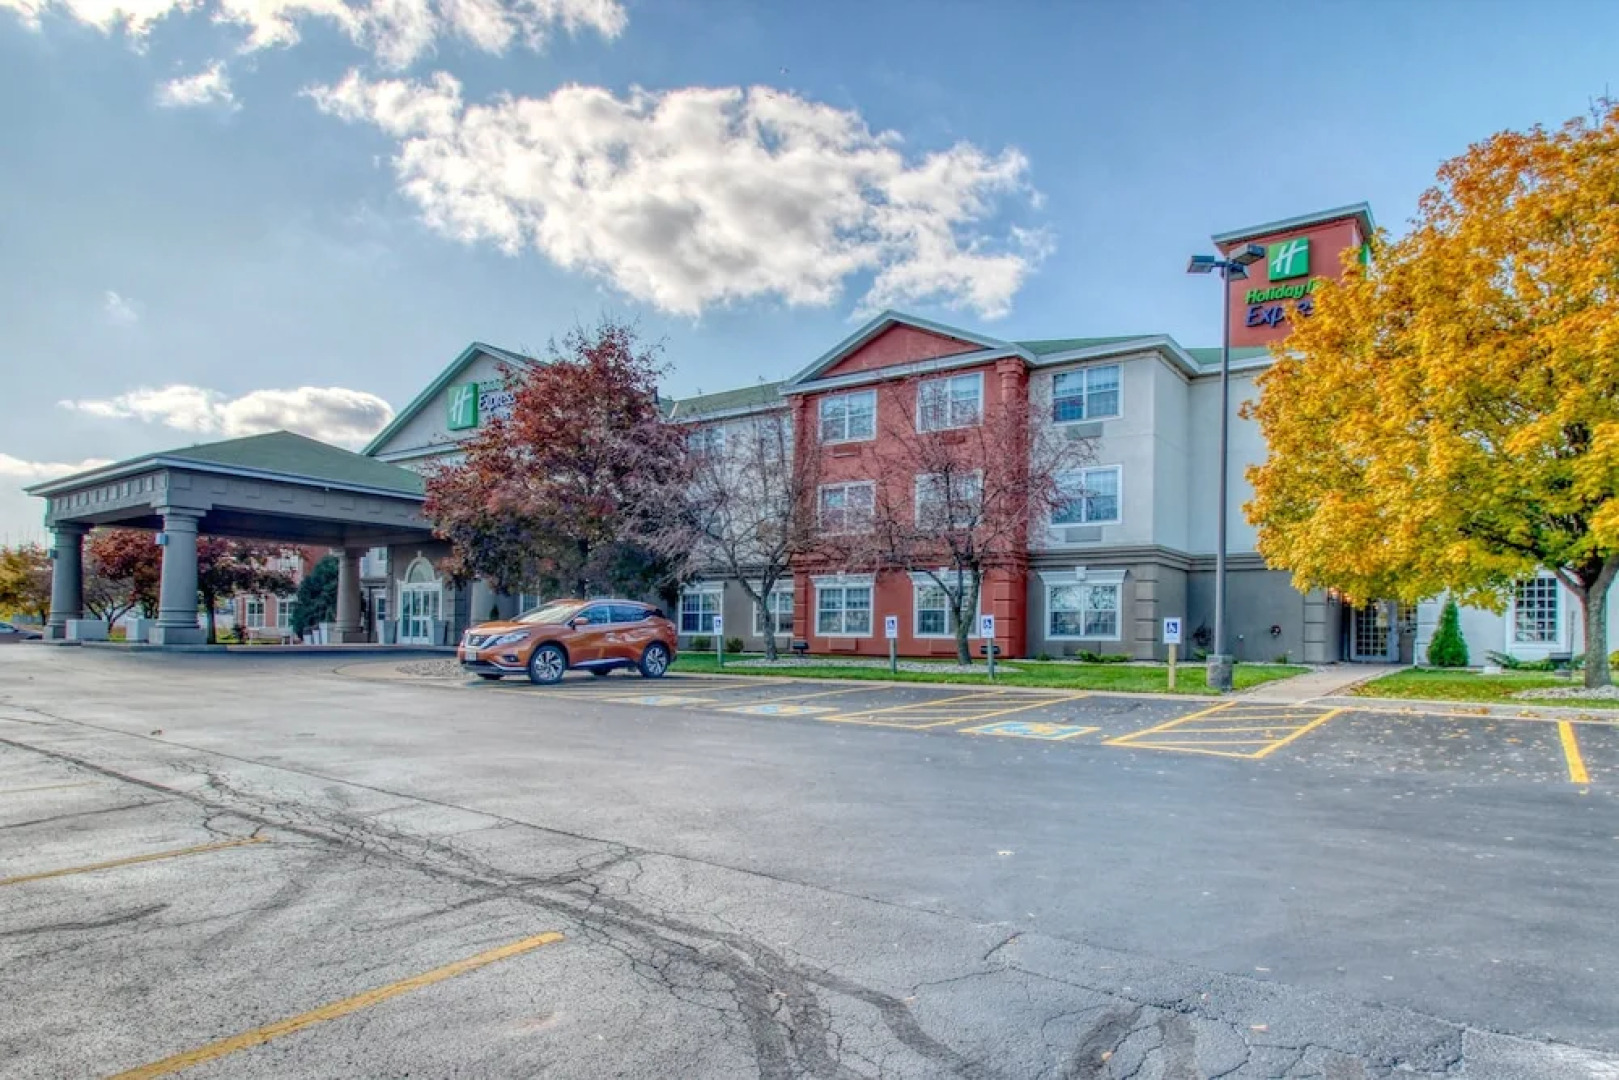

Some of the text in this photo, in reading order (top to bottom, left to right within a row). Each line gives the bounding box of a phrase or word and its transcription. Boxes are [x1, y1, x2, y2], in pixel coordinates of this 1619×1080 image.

[1271, 240, 1308, 274] H
[1245, 284, 1306, 304] Holiday
[1245, 300, 1314, 327] Expe
